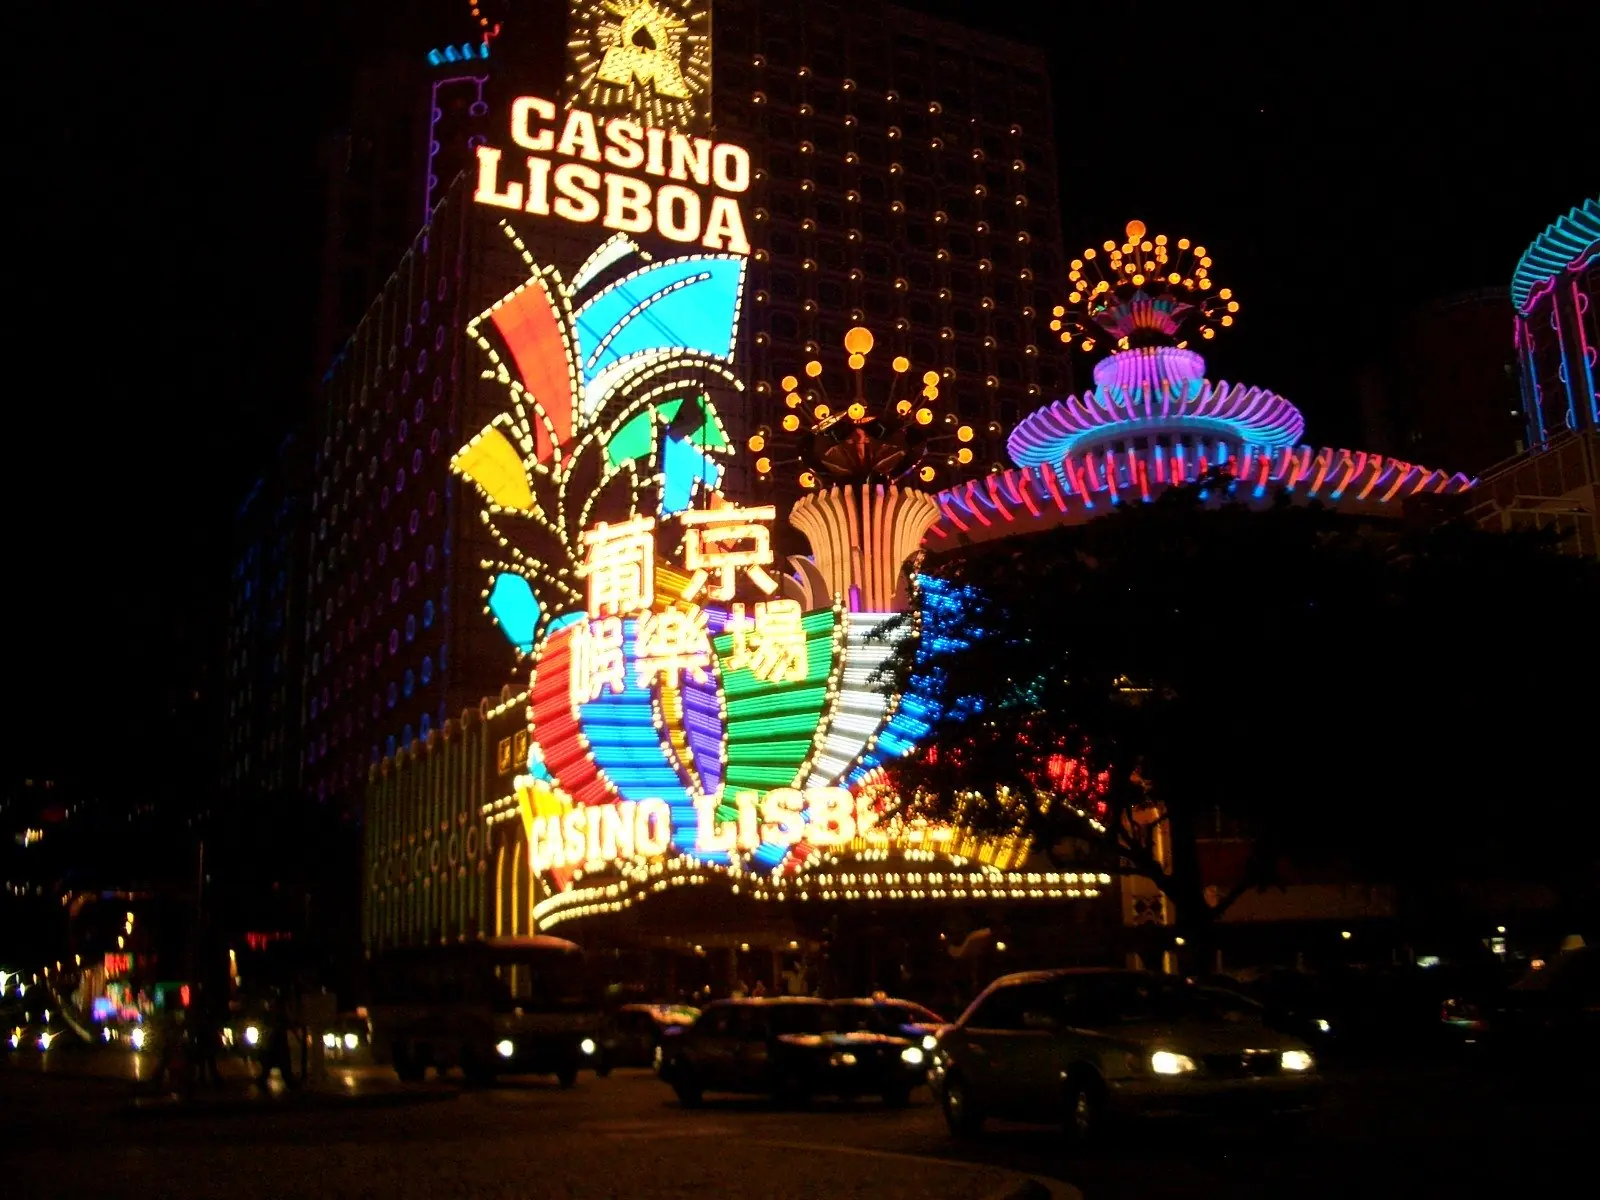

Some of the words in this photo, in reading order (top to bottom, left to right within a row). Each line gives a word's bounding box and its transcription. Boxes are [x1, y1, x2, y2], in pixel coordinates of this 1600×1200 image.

[511, 95, 751, 193] CASINO
[474, 145, 751, 255] LISBOA
[575, 503, 779, 618] 葡京
[530, 797, 671, 872] CASINO
